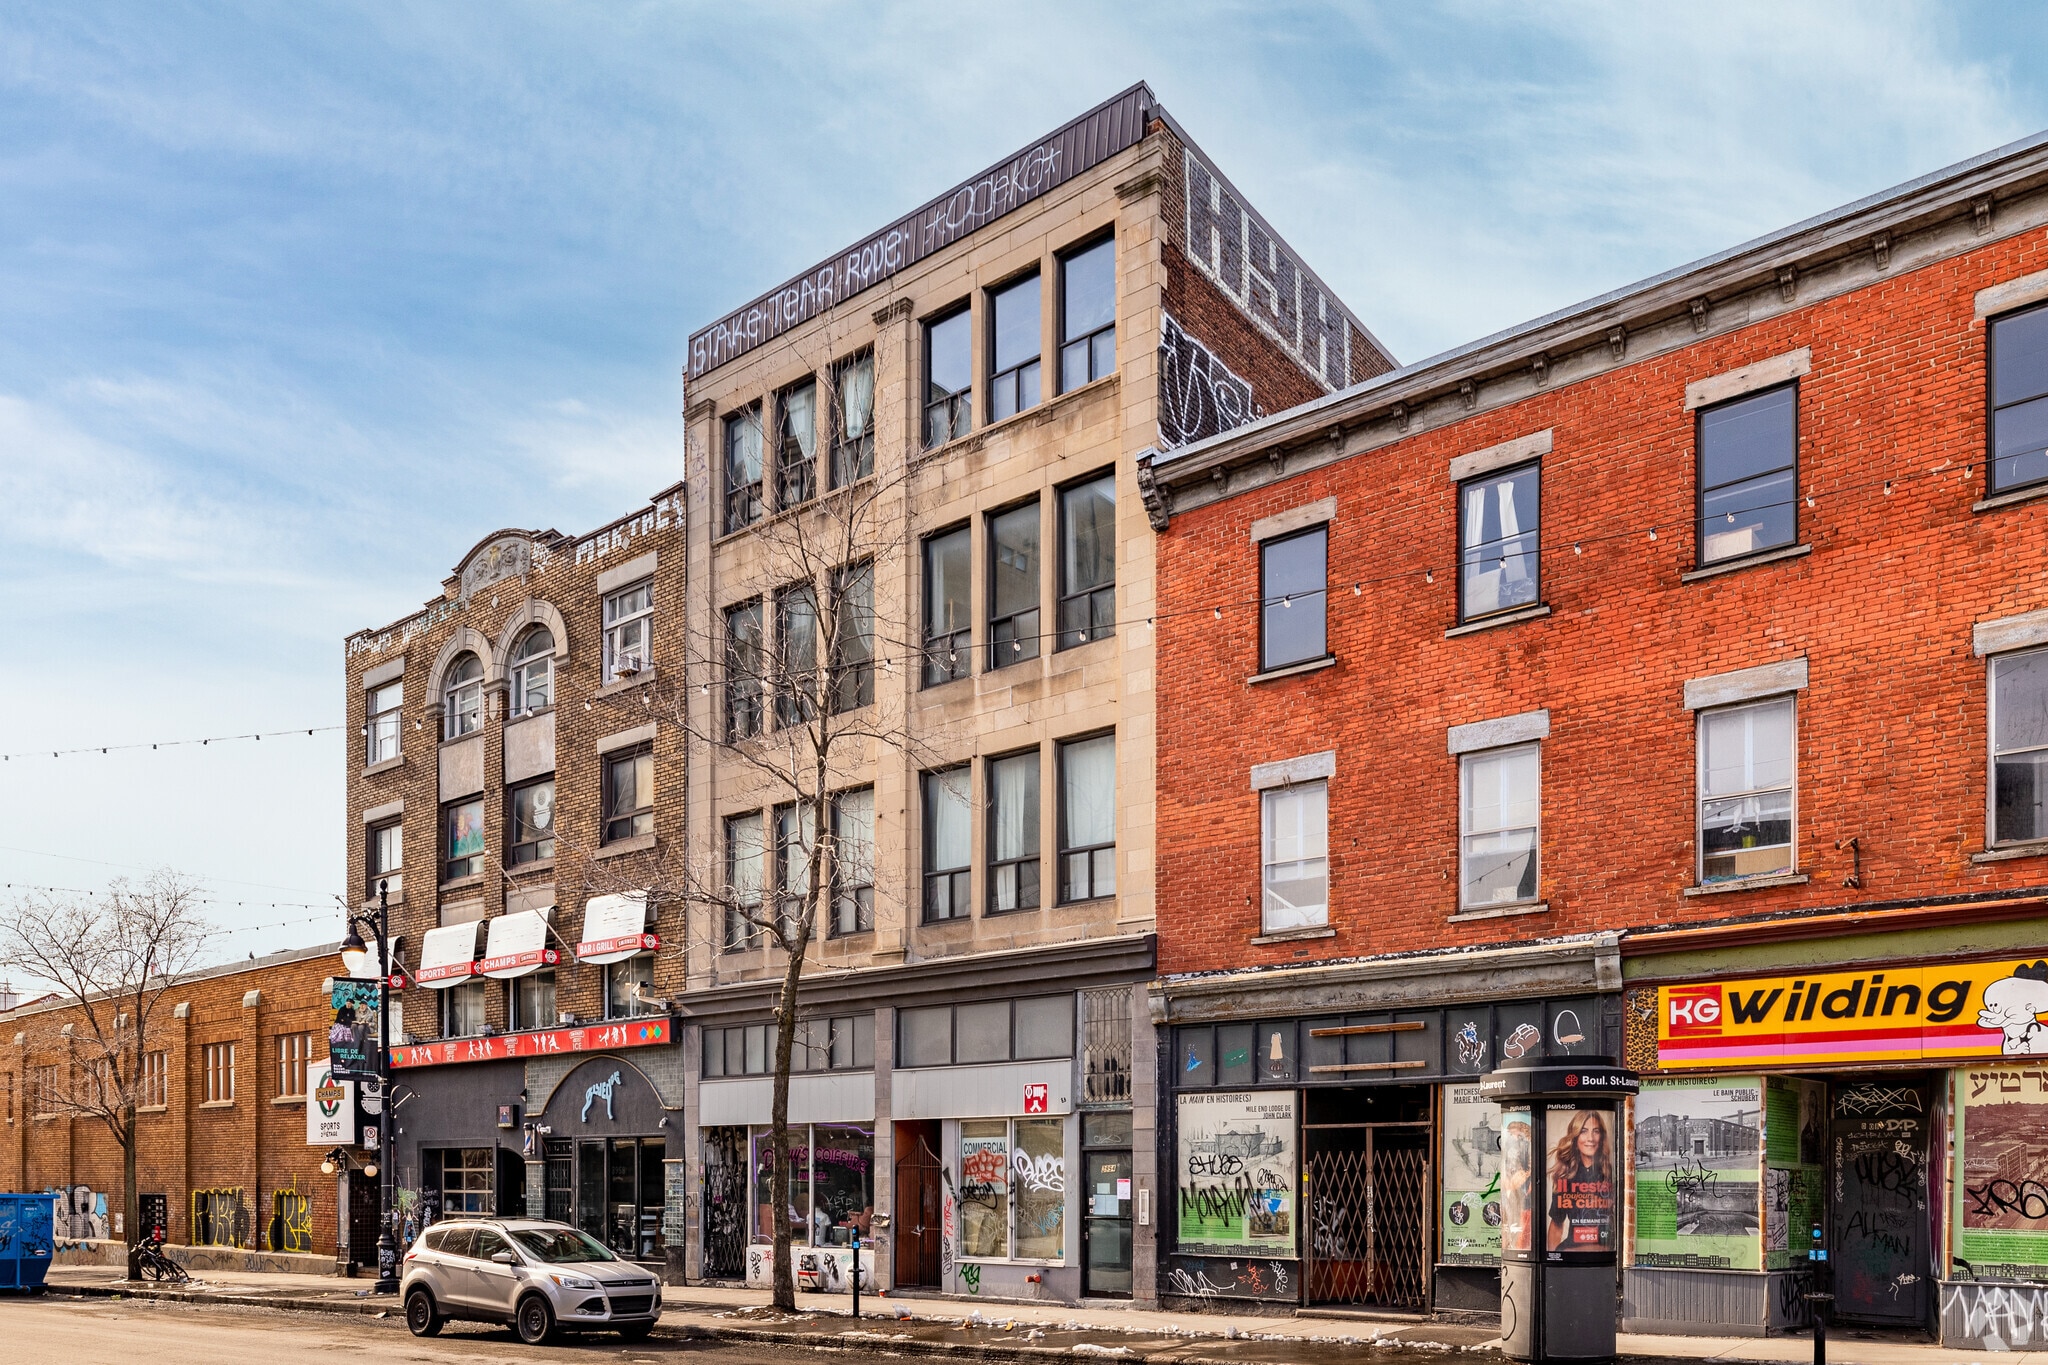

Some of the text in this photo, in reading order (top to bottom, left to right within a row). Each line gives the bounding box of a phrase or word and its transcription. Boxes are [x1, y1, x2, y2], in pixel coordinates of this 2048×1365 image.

[579, 945, 592, 955] BAR
[596, 940, 614, 952] GRILL
[484, 956, 516, 970] CHAMPS
[419, 968, 446, 980] SPORTS
[1670, 997, 1720, 1025] KG
[1582, 1075, 1608, 1086] Boul.
[1647, 1079, 1664, 1087] MAIN
[1666, 1078, 1676, 1086] EN
[317, 1089, 341, 1098] CHAMPS
[1721, 1089, 1734, 1097] BAIN
[1180, 1096, 1187, 1105] LA
[1188, 1095, 1204, 1104] MAIN
[1206, 1095, 1215, 1104] EN
[1453, 1095, 1471, 1104] MARIE
[320, 1122, 341, 1131] SPORTS
[814, 1146, 868, 1175] COIFFURE
[1557, 1178, 1568, 1193] Il
[1557, 1195, 1573, 1209] la
